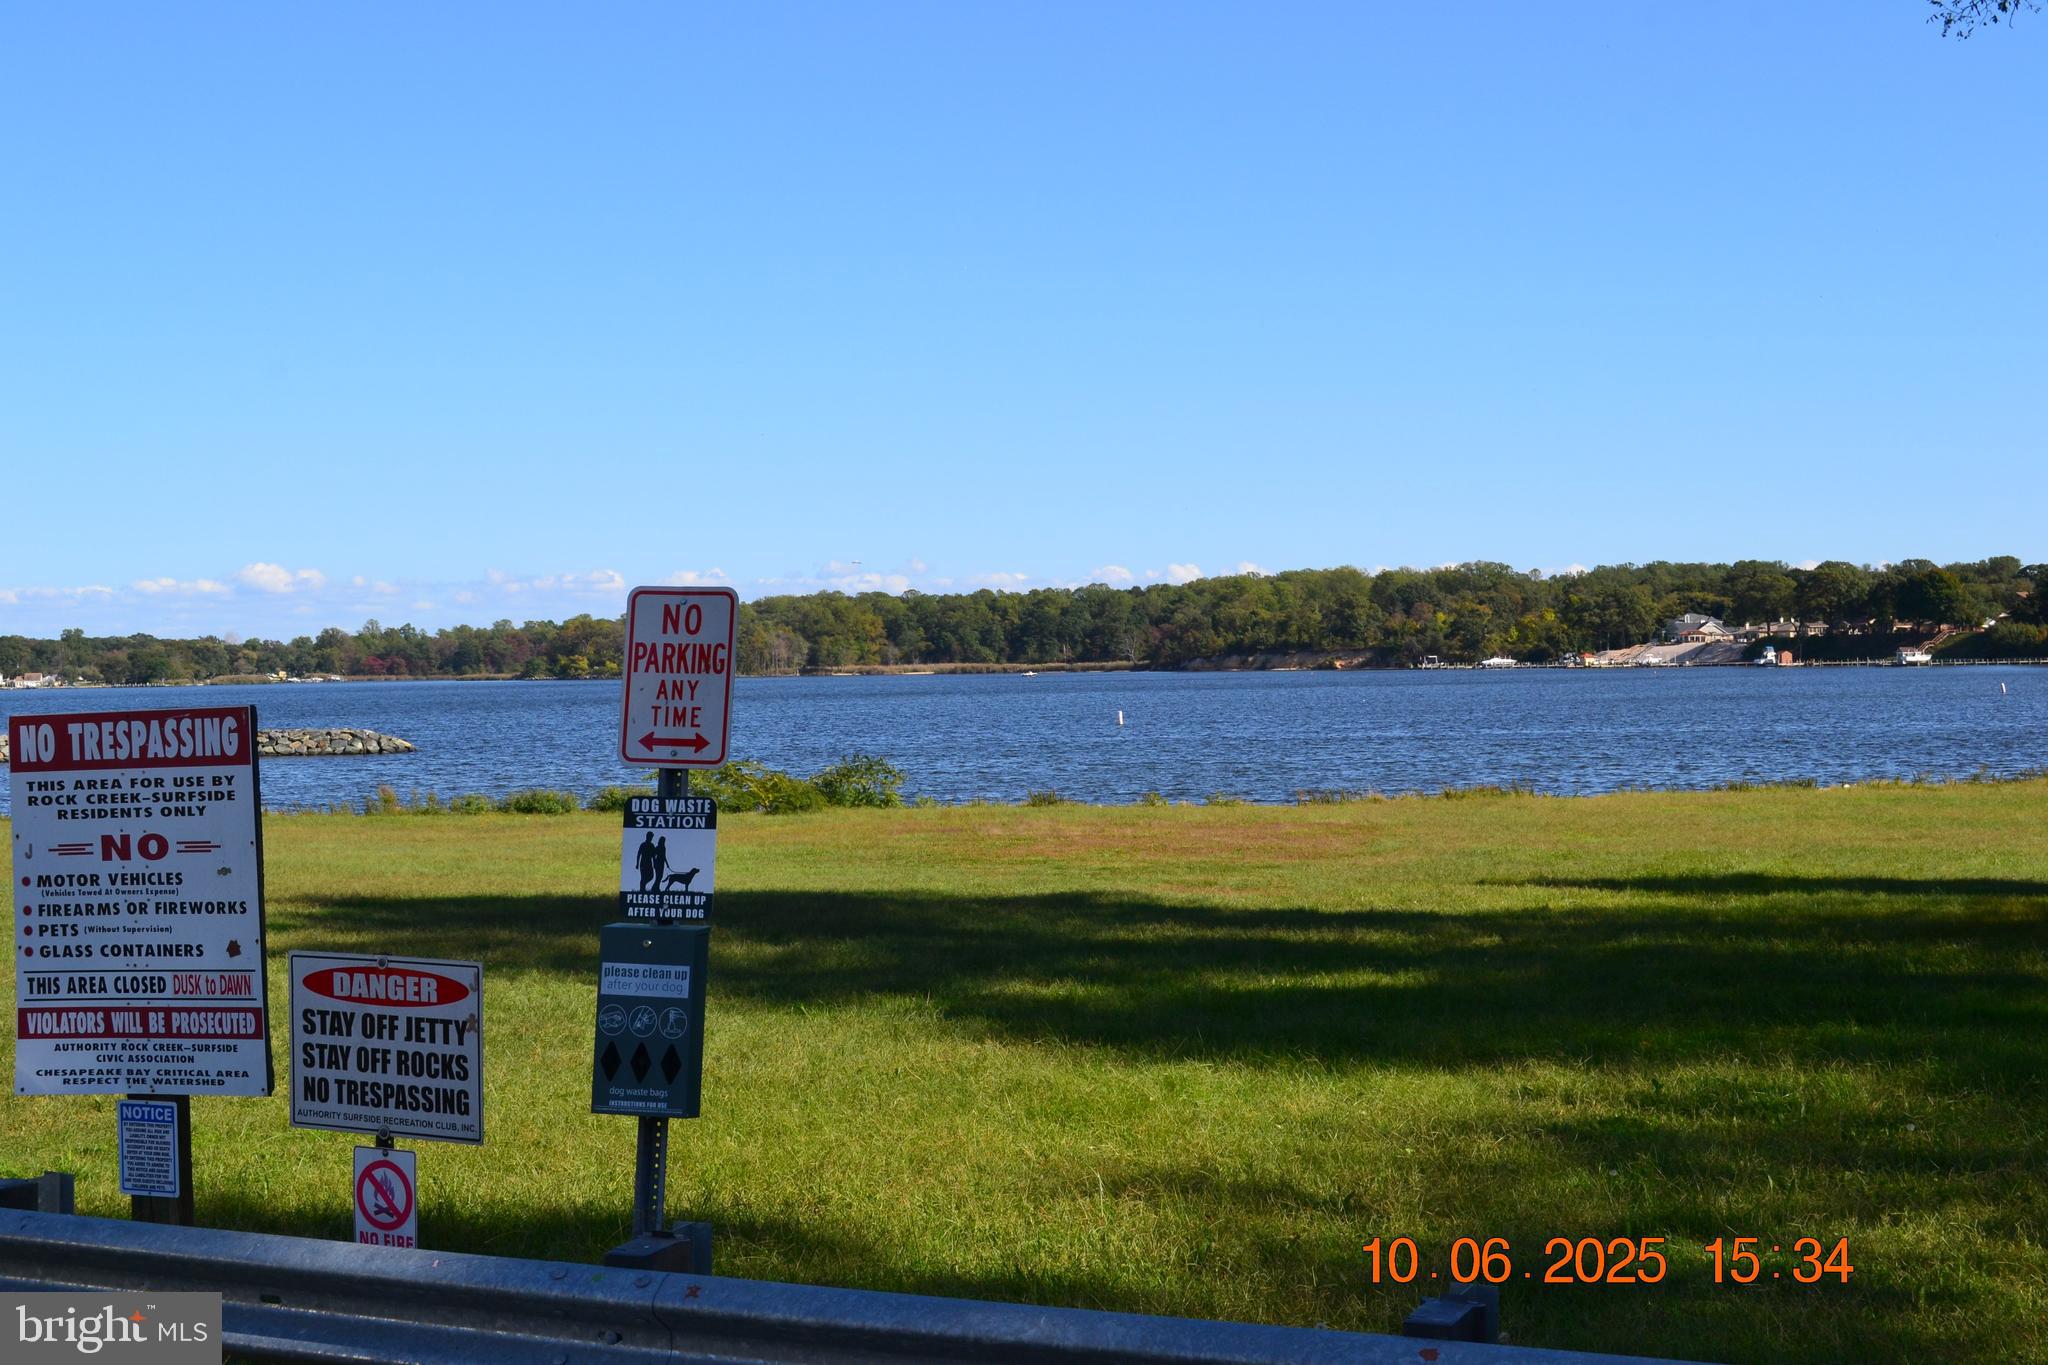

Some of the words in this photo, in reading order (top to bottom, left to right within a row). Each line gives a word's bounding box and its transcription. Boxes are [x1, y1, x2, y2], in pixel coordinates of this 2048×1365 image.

[662, 604, 702, 636] NO
[633, 642, 726, 674] PARKING
[656, 680, 699, 702] ANY
[652, 706, 702, 728] TIME
[19, 724, 55, 763] NO
[68, 716, 239, 761] TRESPASSING
[26, 780, 66, 792] THIS
[74, 778, 120, 790] AREA
[130, 777, 164, 789] FOR
[173, 776, 205, 788] USE
[212, 775, 236, 786] BY
[28, 794, 78, 806] ROCK
[632, 798, 660, 812] DOG
[666, 799, 710, 813] WASTE
[57, 806, 152, 820] RESIDENTS
[160, 806, 206, 817] ONLY
[636, 816, 706, 828] STATION
[101, 833, 170, 862] NO
[36, 874, 100, 888] MOTOR
[108, 872, 183, 886] VEHICLES
[41, 888, 75, 898] (Vehicles
[78, 888, 102, 897] Towed
[115, 888, 144, 896] Owners
[146, 888, 179, 898] Expense)
[627, 894, 660, 904] PLEASE
[664, 894, 691, 905] CLEAN
[694, 896, 706, 905] UP
[38, 902, 120, 917] FIREARMS
[127, 902, 148, 915] OR
[154, 901, 247, 914] FIREWORKS
[628, 907, 656, 917] AFTER
[660, 908, 682, 918] YOUR
[686, 908, 704, 918] DOG
[39, 924, 79, 937] PETS
[84, 924, 120, 934] (Without
[122, 924, 172, 934] Supervision)
[40, 944, 93, 958] GLASS
[100, 944, 204, 958] CONTAINERS
[604, 966, 640, 978] please
[642, 968, 671, 980] clean
[675, 970, 688, 981] up
[27, 976, 60, 994] THIS
[67, 976, 107, 994] AREA
[114, 976, 167, 994] CLOSED
[172, 974, 202, 995] DUSK
[206, 976, 216, 994] to
[220, 975, 251, 996] DAWN
[332, 972, 438, 1002] DANGER
[607, 979, 632, 990] after
[636, 982, 659, 992] your
[662, 981, 683, 994] dog
[26, 1012, 105, 1034] VIOLATORS
[111, 1012, 143, 1034] WILL
[149, 1012, 166, 1034] BE
[172, 1012, 256, 1034] PROSECUTED
[302, 1008, 355, 1037] STAY
[362, 1013, 399, 1040] OFF
[404, 1016, 468, 1046] JETTY
[54, 1043, 117, 1052] AUTHORITY
[122, 1044, 148, 1052] ROCK
[96, 1054, 124, 1062] CIVIC
[128, 1054, 194, 1063] ASSOCIATION
[302, 1042, 351, 1070] STAY
[356, 1046, 390, 1074] OFF
[397, 1050, 469, 1081] ROCKS
[36, 1068, 122, 1077] CHESAPEAKE
[156, 1069, 210, 1077] CRITICAL
[151, 1078, 225, 1086] WATERSHED
[304, 1076, 330, 1103] NO
[335, 1079, 470, 1116] TRESPASSING
[610, 1086, 624, 1096] dog
[650, 1088, 668, 1098] bags
[122, 1106, 172, 1120] NOTICE
[298, 1108, 340, 1120] AUTHORITY
[343, 1113, 381, 1124] SURFSIDE
[384, 1116, 433, 1128] RECREATION
[436, 1121, 460, 1132] CLUB,
[462, 1124, 477, 1133] INC.
[360, 1231, 379, 1245] NO
